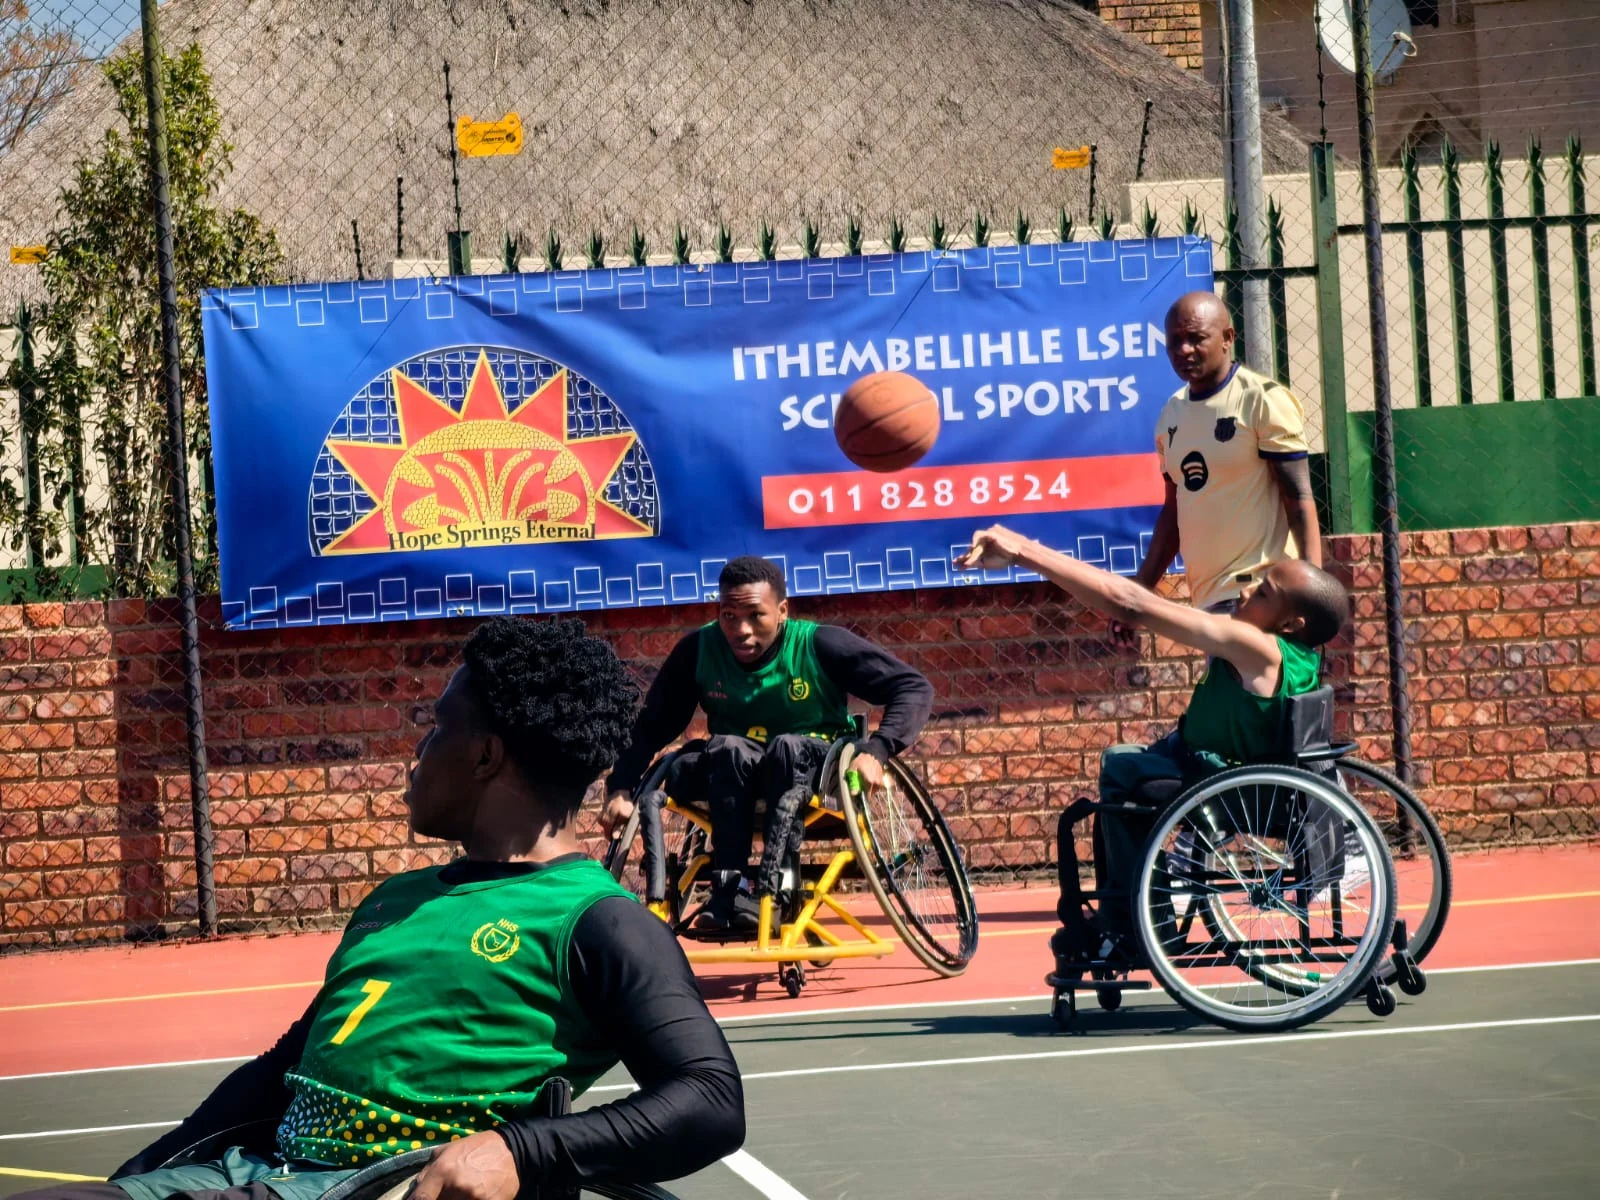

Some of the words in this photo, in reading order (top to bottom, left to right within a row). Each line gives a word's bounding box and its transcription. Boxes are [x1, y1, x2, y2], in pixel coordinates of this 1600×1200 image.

[732, 328, 1064, 381] ITHEMBELIHLE
[779, 386, 964, 431] SCL
[975, 375, 1140, 420] SPORTS
[788, 484, 862, 515] 011
[880, 478, 955, 511] 828
[969, 470, 1072, 504] 8524
[388, 532, 443, 551] Hope
[446, 521, 522, 547] Springs
[525, 518, 597, 540] Eternal
[496, 917, 519, 932] NHS
